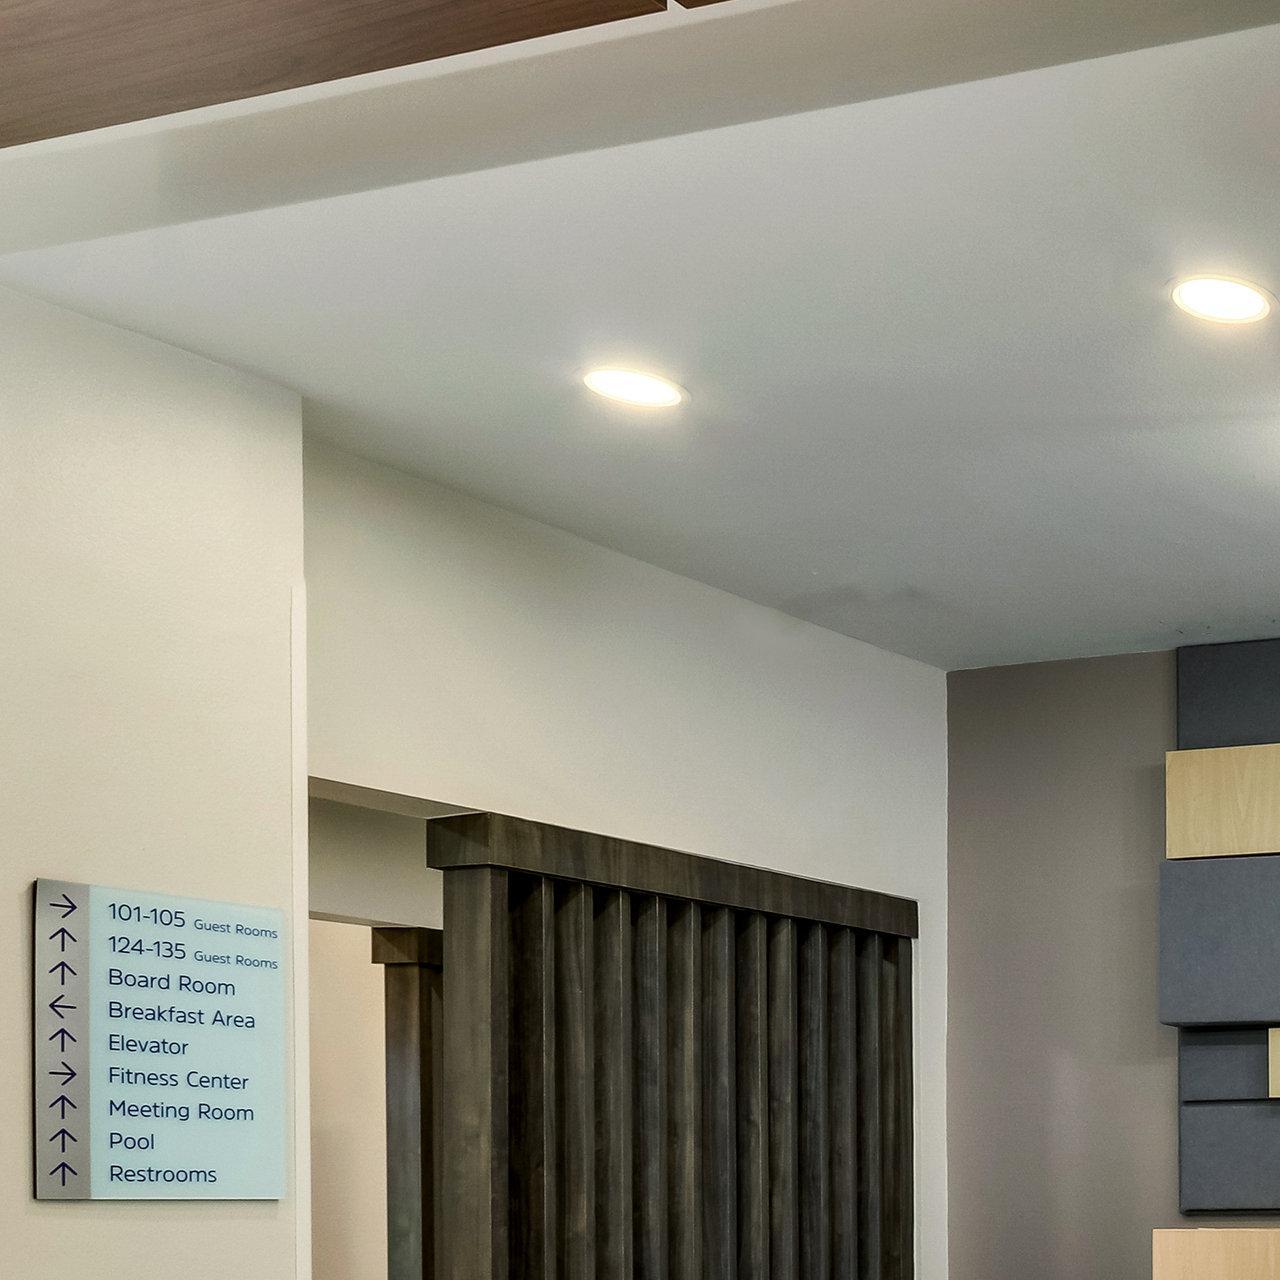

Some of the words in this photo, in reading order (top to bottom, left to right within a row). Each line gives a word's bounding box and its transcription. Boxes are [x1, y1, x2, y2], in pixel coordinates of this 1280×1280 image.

[108, 903, 186, 928] 101-105
[194, 918, 231, 934] Guest
[235, 924, 279, 940] Rooms
[108, 936, 186, 960] 124-135
[194, 950, 231, 965] Guest
[235, 955, 279, 970] Rooms
[109, 969, 170, 990] Board
[179, 975, 236, 996] Room
[109, 1001, 205, 1025] Breakfast
[212, 1010, 256, 1029] Area
[109, 1034, 189, 1055] Elevator
[109, 1067, 179, 1087] Fitness
[186, 1071, 249, 1090] Center
[109, 1100, 190, 1121] Meeting
[198, 1104, 255, 1121] Room
[109, 1132, 155, 1150] Pool
[109, 1165, 217, 1183] Restrooms
